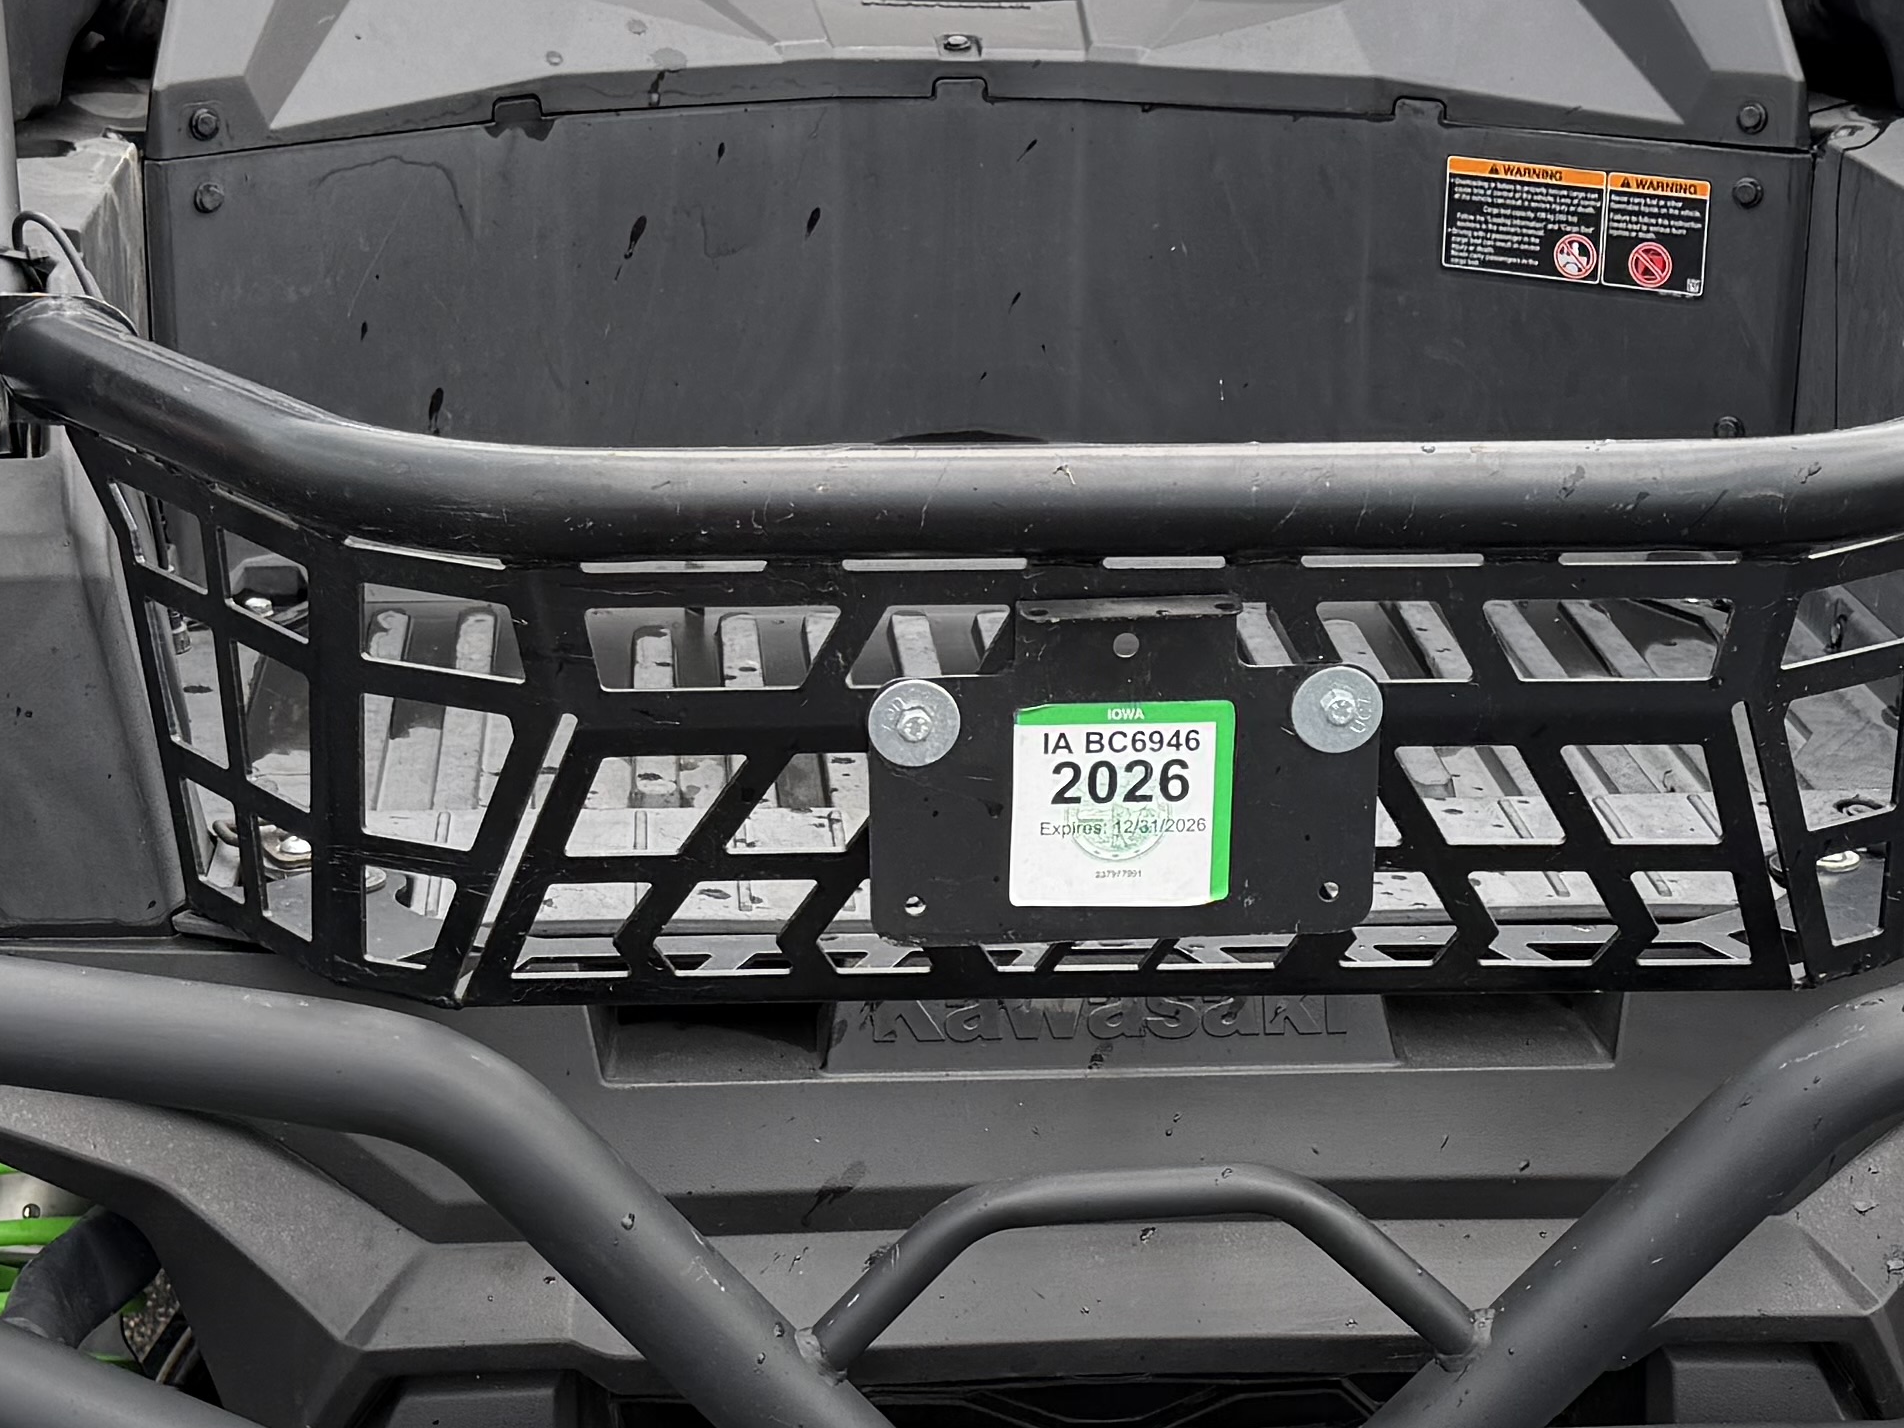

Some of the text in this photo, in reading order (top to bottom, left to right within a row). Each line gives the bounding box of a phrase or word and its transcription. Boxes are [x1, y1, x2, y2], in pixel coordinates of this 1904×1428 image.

[1503, 164, 1563, 181] WARNING
[1635, 178, 1698, 195] WARNING
[1107, 708, 1145, 721] IOWA
[1043, 729, 1201, 755] IA BC6946
[1051, 759, 1190, 805] 2026
[1040, 818, 1207, 839] Expires: 12/31/2026
